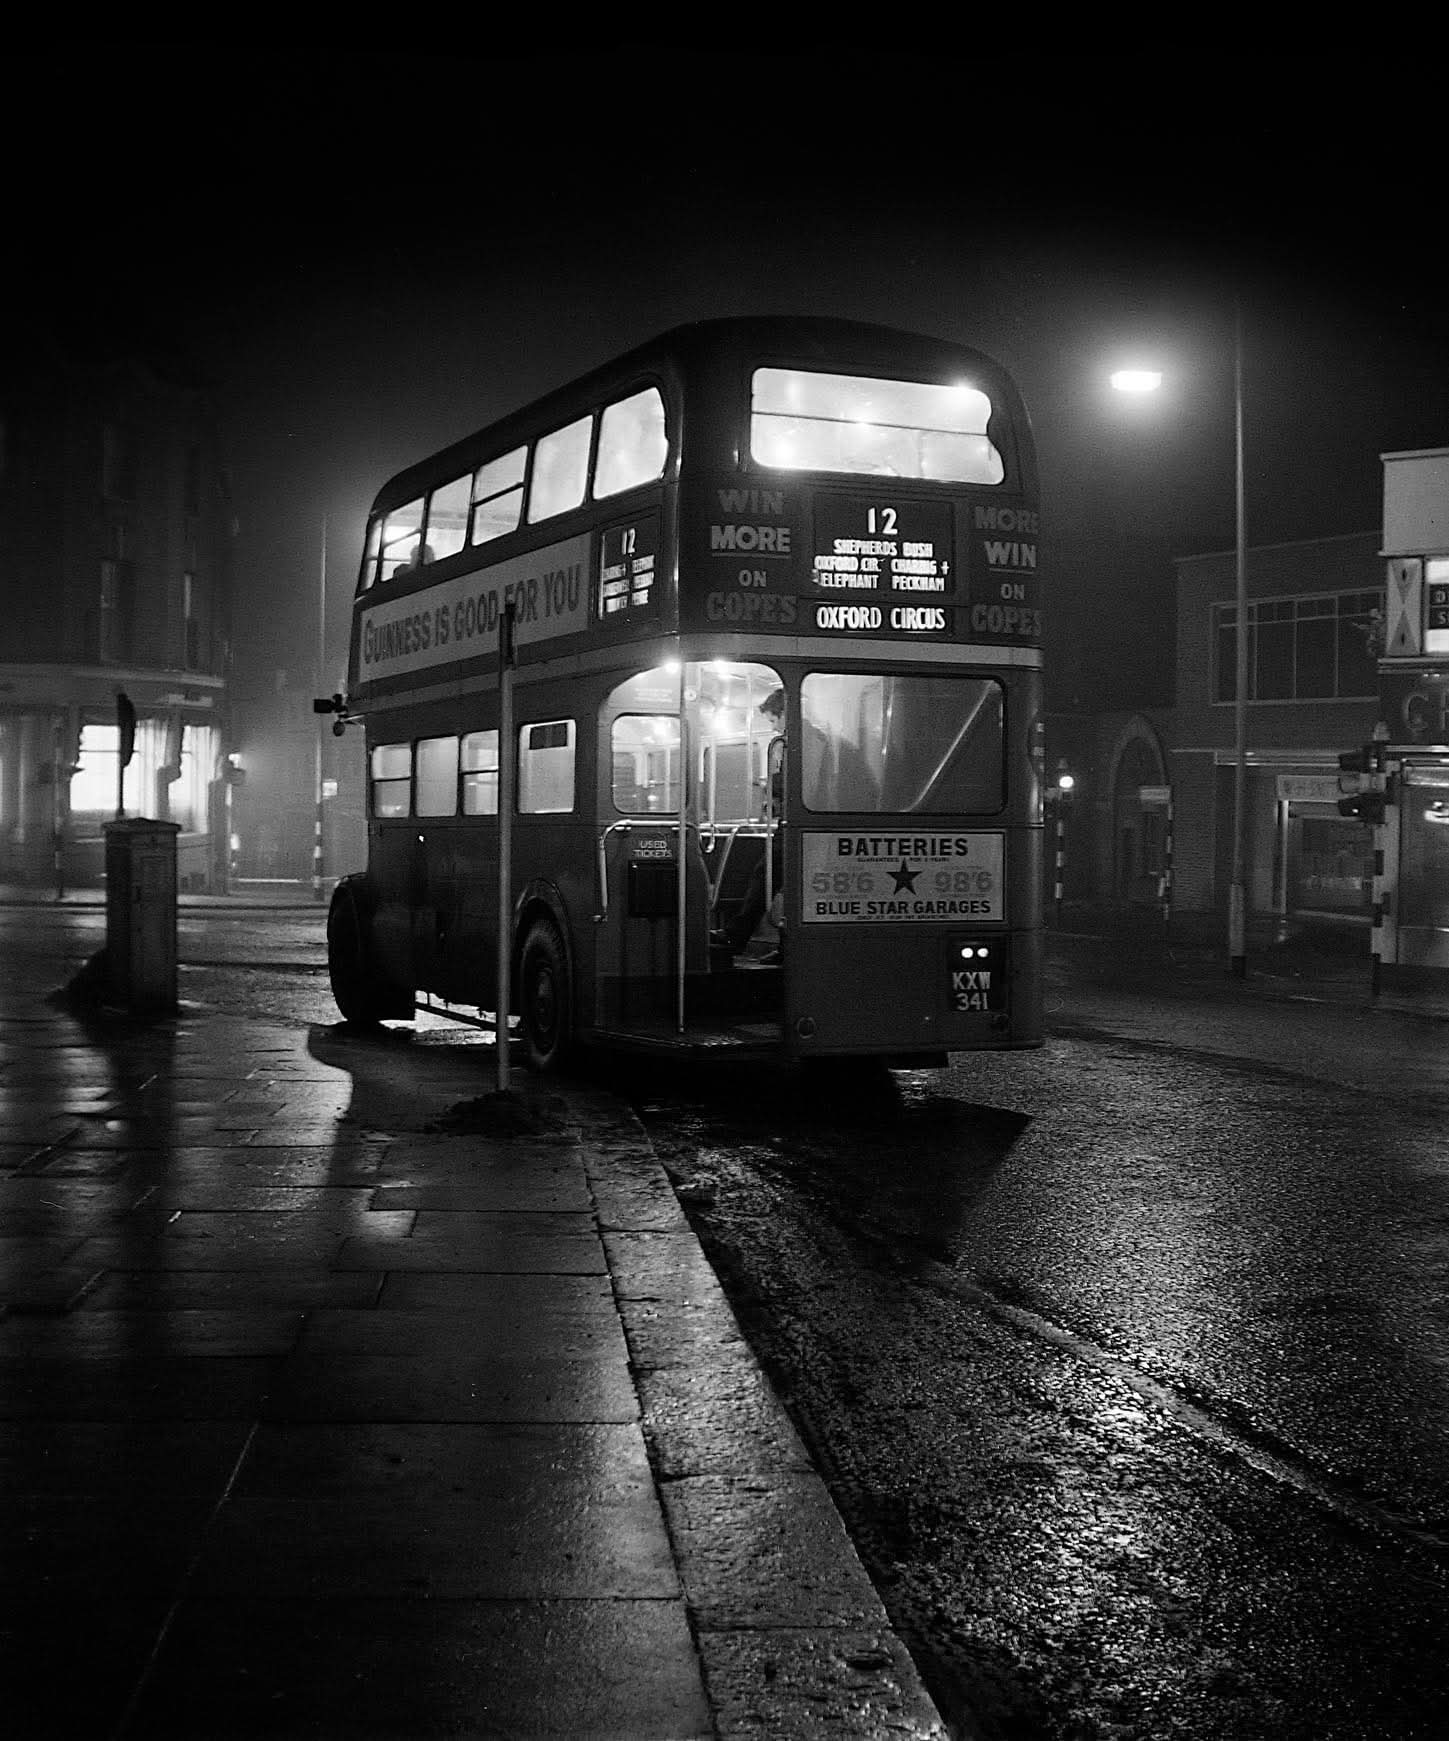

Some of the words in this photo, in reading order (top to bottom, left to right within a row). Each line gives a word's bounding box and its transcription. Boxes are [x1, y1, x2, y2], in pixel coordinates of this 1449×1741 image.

[718, 488, 784, 514] WIN
[868, 507, 898, 534] 12
[975, 506, 1038, 533] MORE
[622, 527, 636, 555] 12
[711, 525, 791, 552] MORE
[984, 541, 1037, 568] WIN
[738, 569, 767, 587] ON
[820, 573, 878, 589] ELEPHANT
[892, 576, 945, 591] PECKHAM
[1001, 583, 1025, 600] ON
[364, 611, 431, 664] GUINNESS
[435, 605, 449, 647] IS
[454, 590, 498, 641] GOOD
[544, 563, 580, 617] YOU
[706, 591, 797, 623] COPES
[817, 606, 882, 629] OXFORD
[890, 608, 946, 630] CIRCUS
[641, 840, 668, 849] USED
[838, 838, 969, 856] BATTERIES
[816, 902, 861, 915] BLUE
[867, 901, 909, 914] STAR
[914, 900, 992, 914] GARAGES
[952, 971, 991, 990] KXW
[956, 992, 988, 1011] 341
